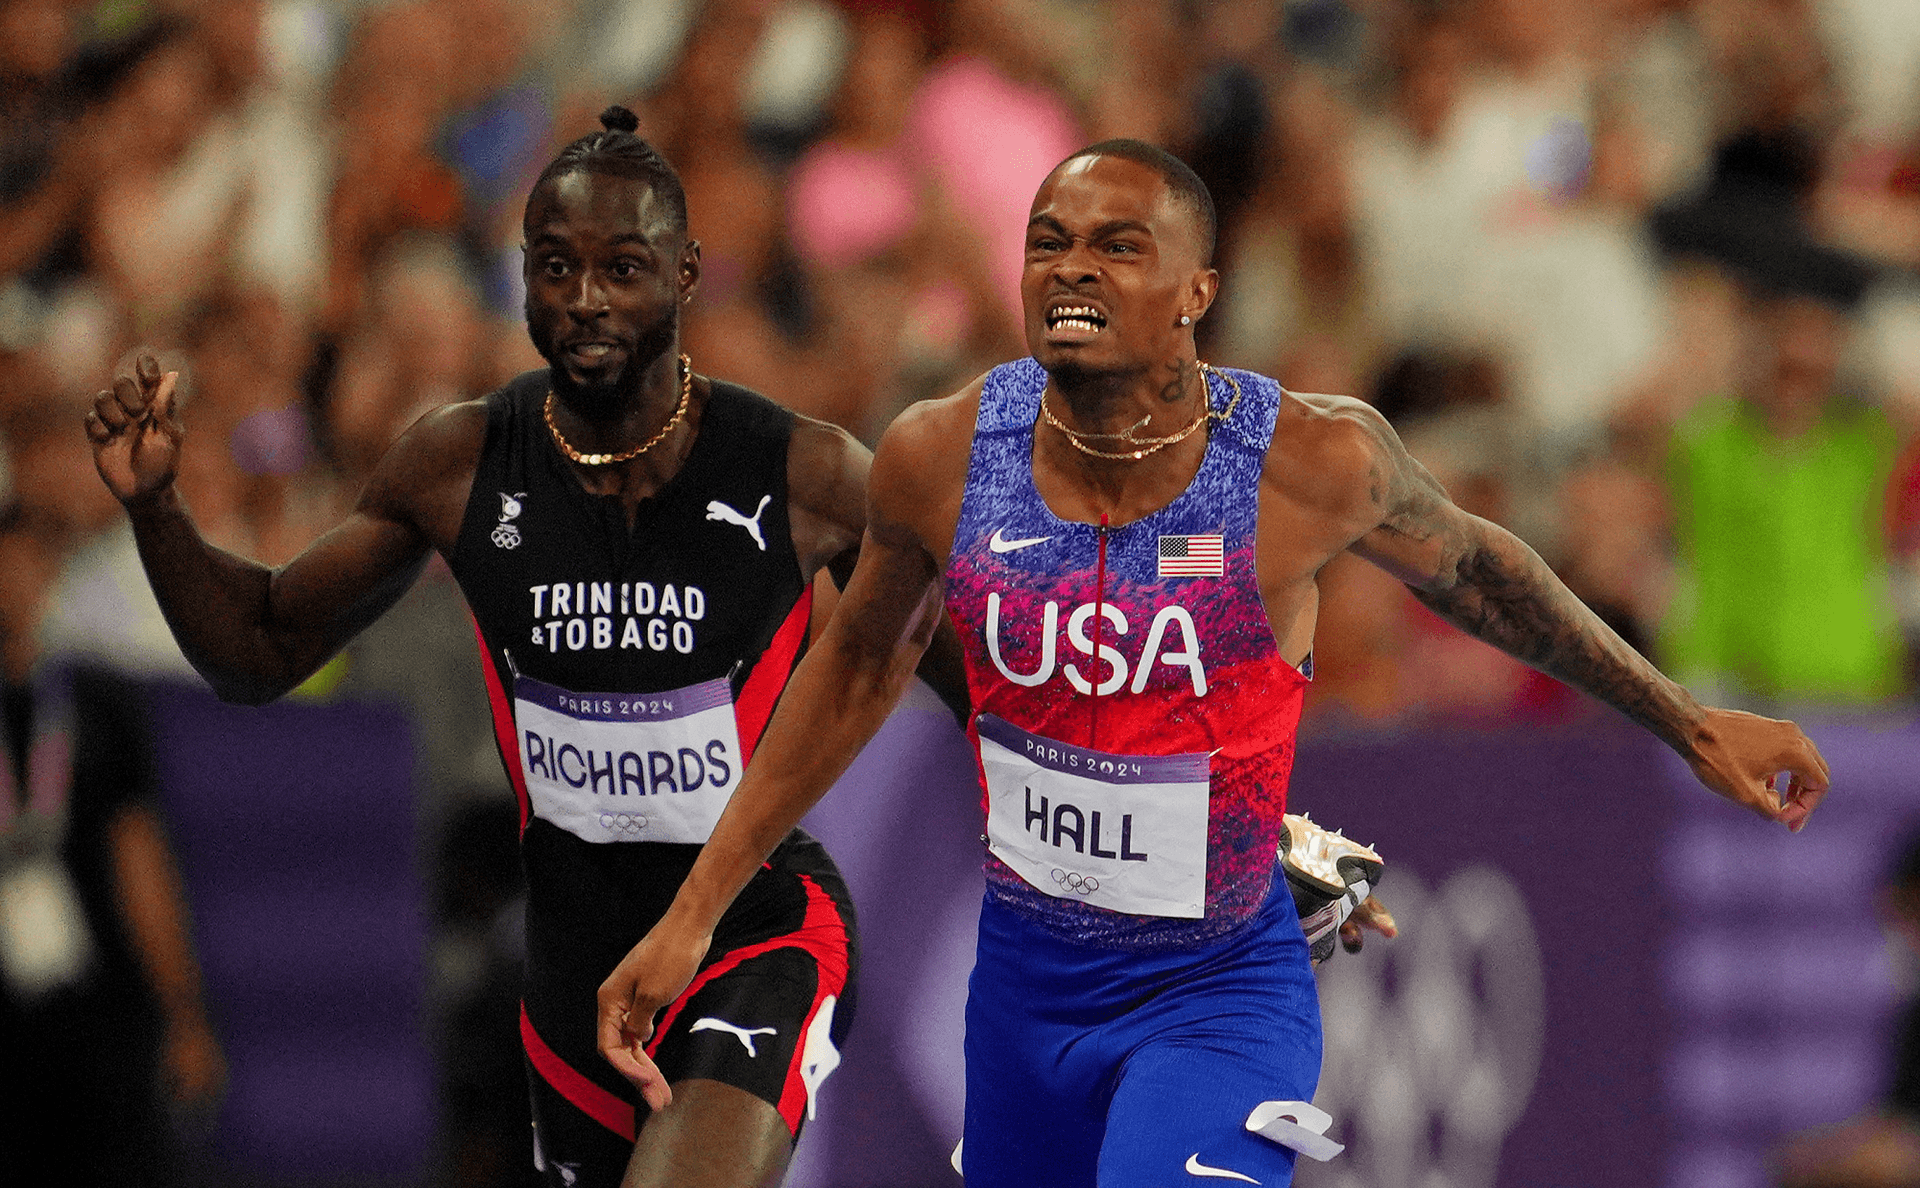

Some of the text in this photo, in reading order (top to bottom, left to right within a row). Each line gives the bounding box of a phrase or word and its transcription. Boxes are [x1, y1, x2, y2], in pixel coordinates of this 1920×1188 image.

[530, 581, 706, 621] TRINIDAD
[985, 592, 1208, 697] USA
[558, 694, 675, 715] PARIS 2024
[525, 729, 731, 797] RICHARDS
[1026, 738, 1142, 777] PARIS 2024
[1025, 785, 1148, 863] HALL
